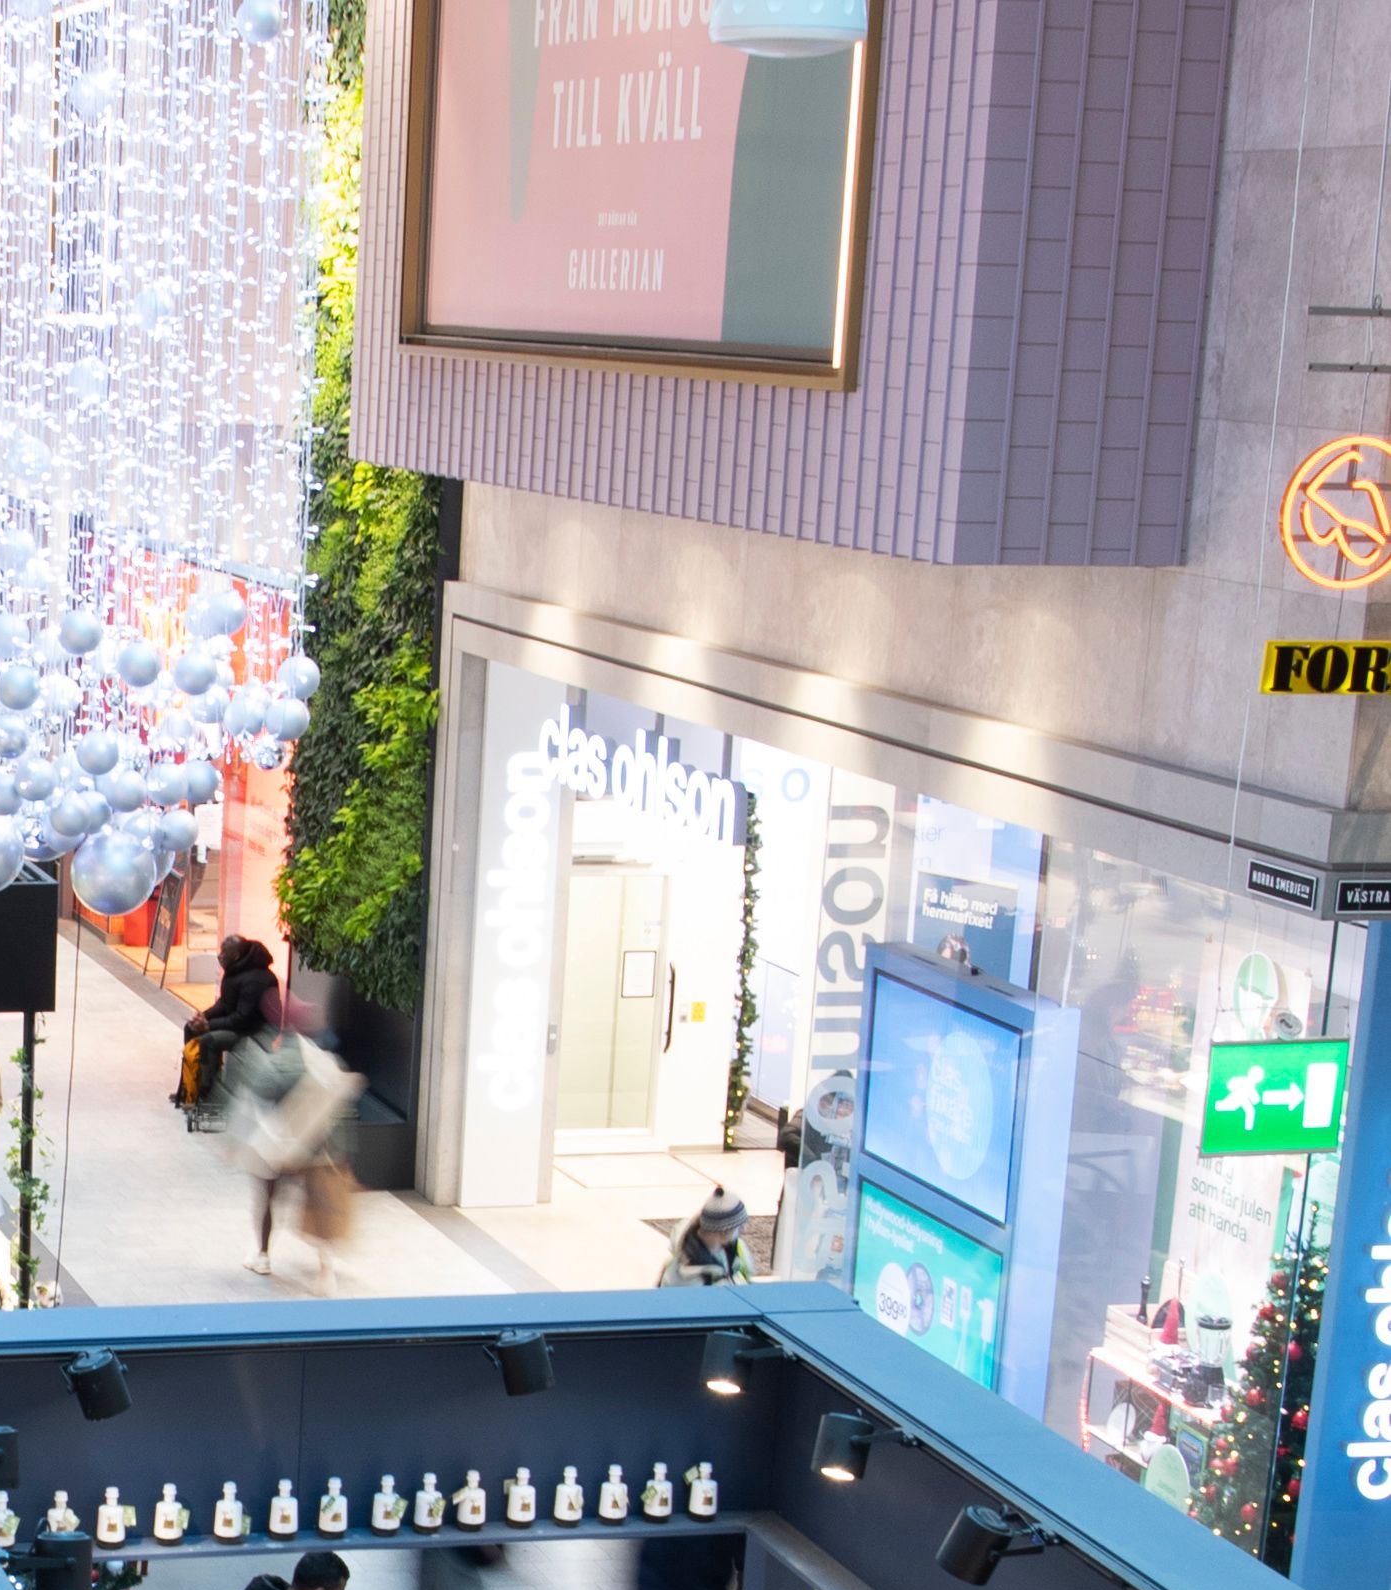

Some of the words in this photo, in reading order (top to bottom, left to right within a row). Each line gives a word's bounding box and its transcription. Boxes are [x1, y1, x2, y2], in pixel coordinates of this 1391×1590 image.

[552, 76, 602, 149] TILL
[617, 51, 703, 145] KVÄLL
[567, 248, 665, 291] GALLERIAN
[539, 703, 608, 800] clas
[611, 728, 735, 848] ohlson
[924, 888, 939, 903] Få
[971, 900, 998, 915] med
[1347, 888, 1390, 904] VÄSTRA
[1188, 1201, 1206, 1224] att
[1191, 1175, 1219, 1202] som
[1239, 1193, 1272, 1227] julen
